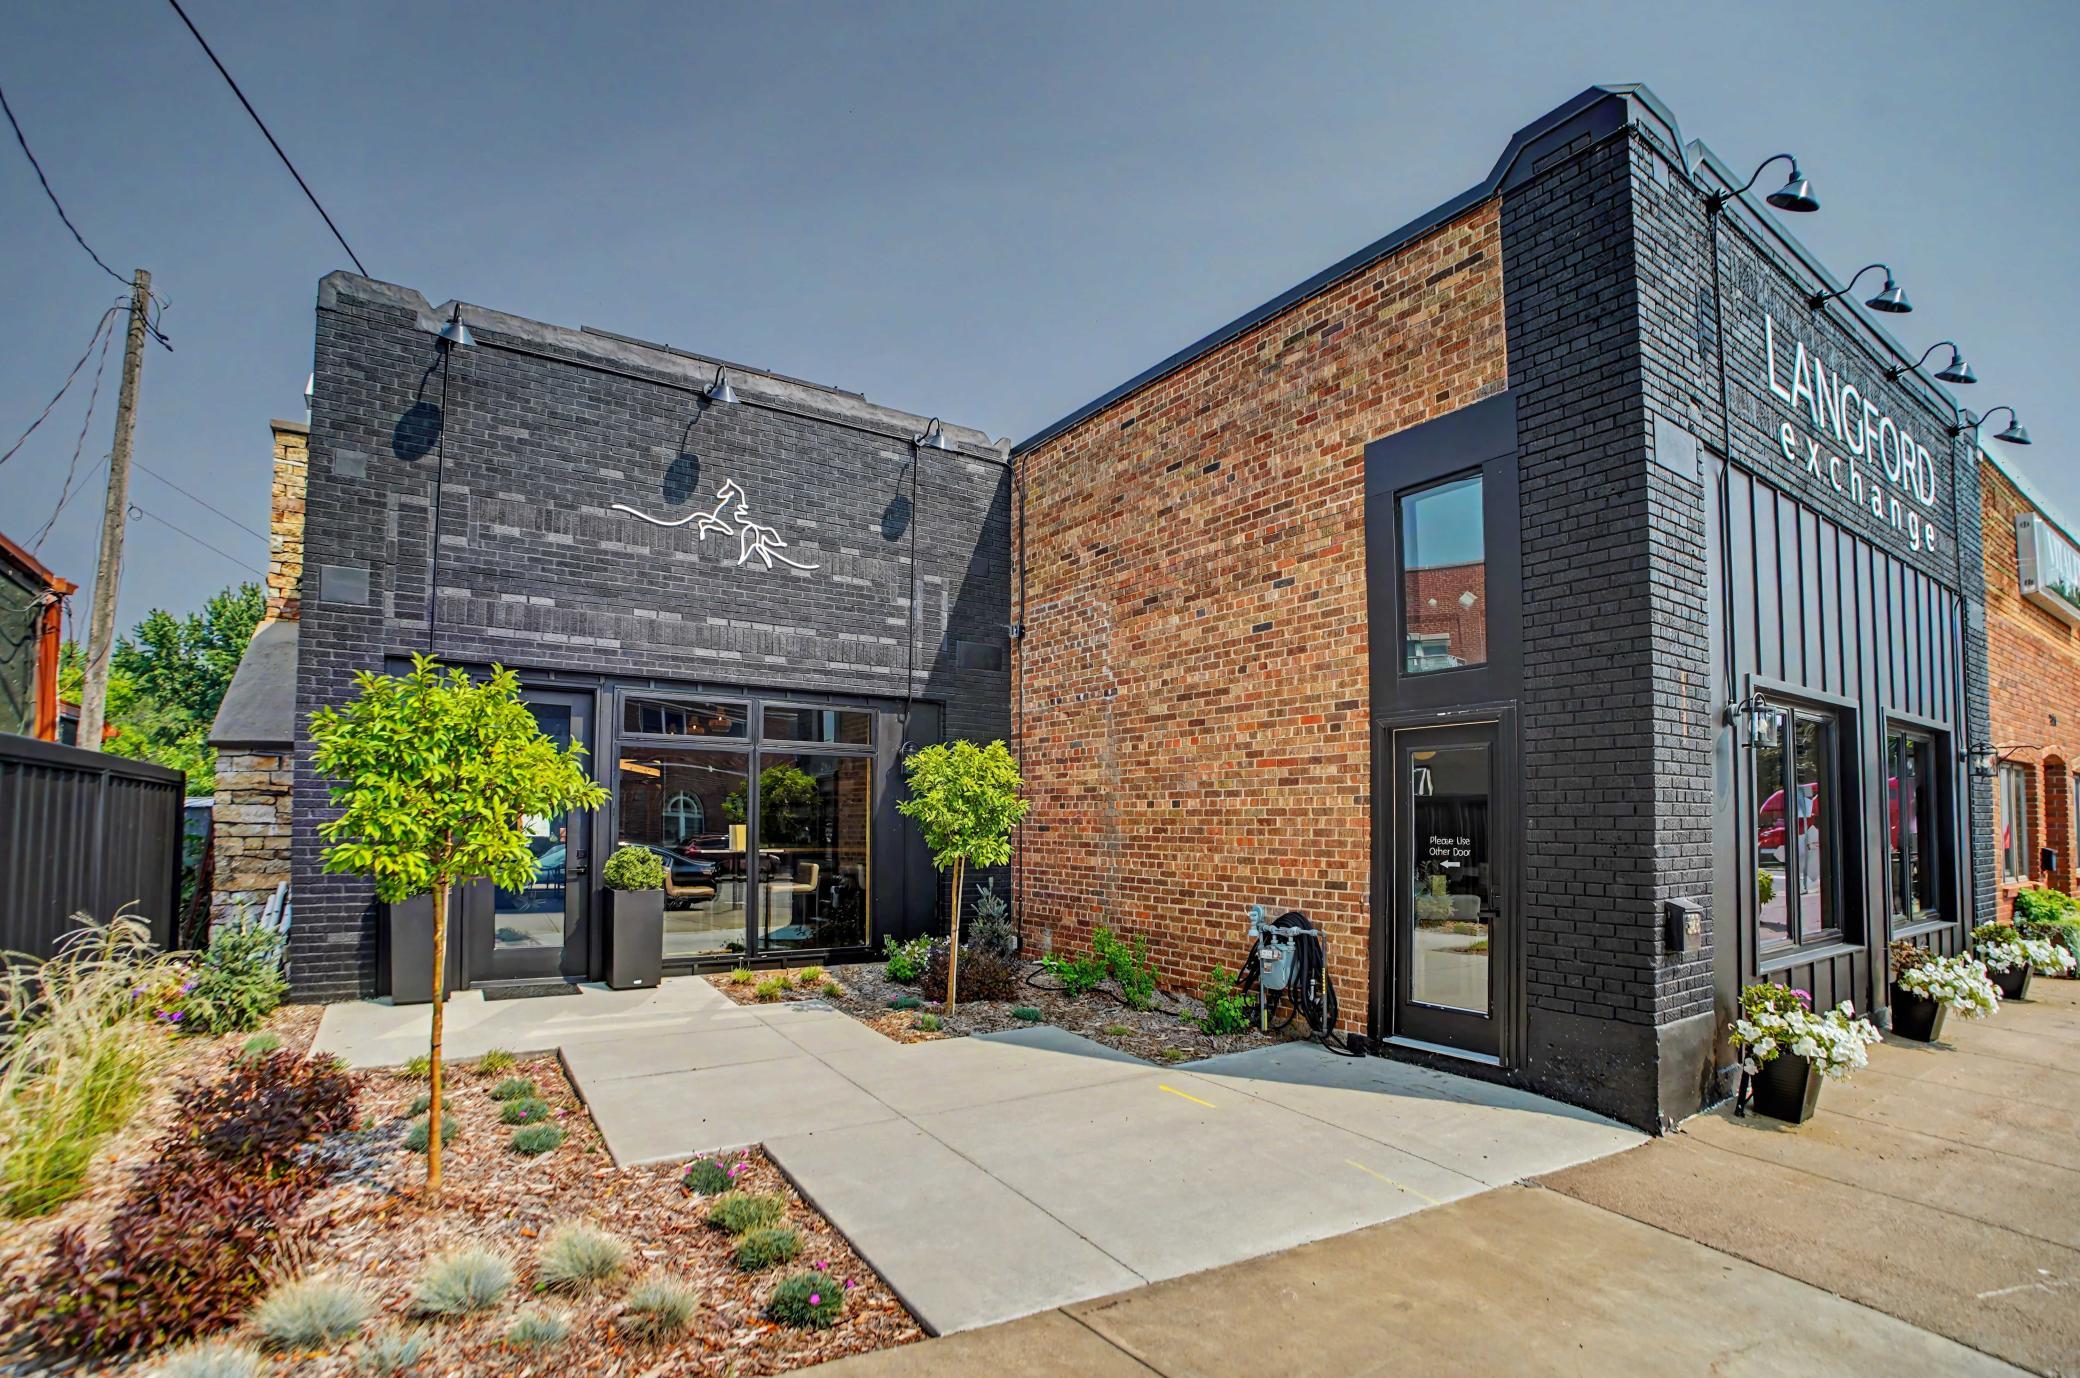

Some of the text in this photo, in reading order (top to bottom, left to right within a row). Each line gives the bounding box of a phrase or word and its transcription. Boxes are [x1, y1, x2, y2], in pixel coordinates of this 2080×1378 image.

[1765, 313, 1935, 506] LANGFORD
[1780, 422, 1935, 551] exchange
[1429, 835, 1471, 846] Please Use
[1429, 846, 1471, 857] Other Door
